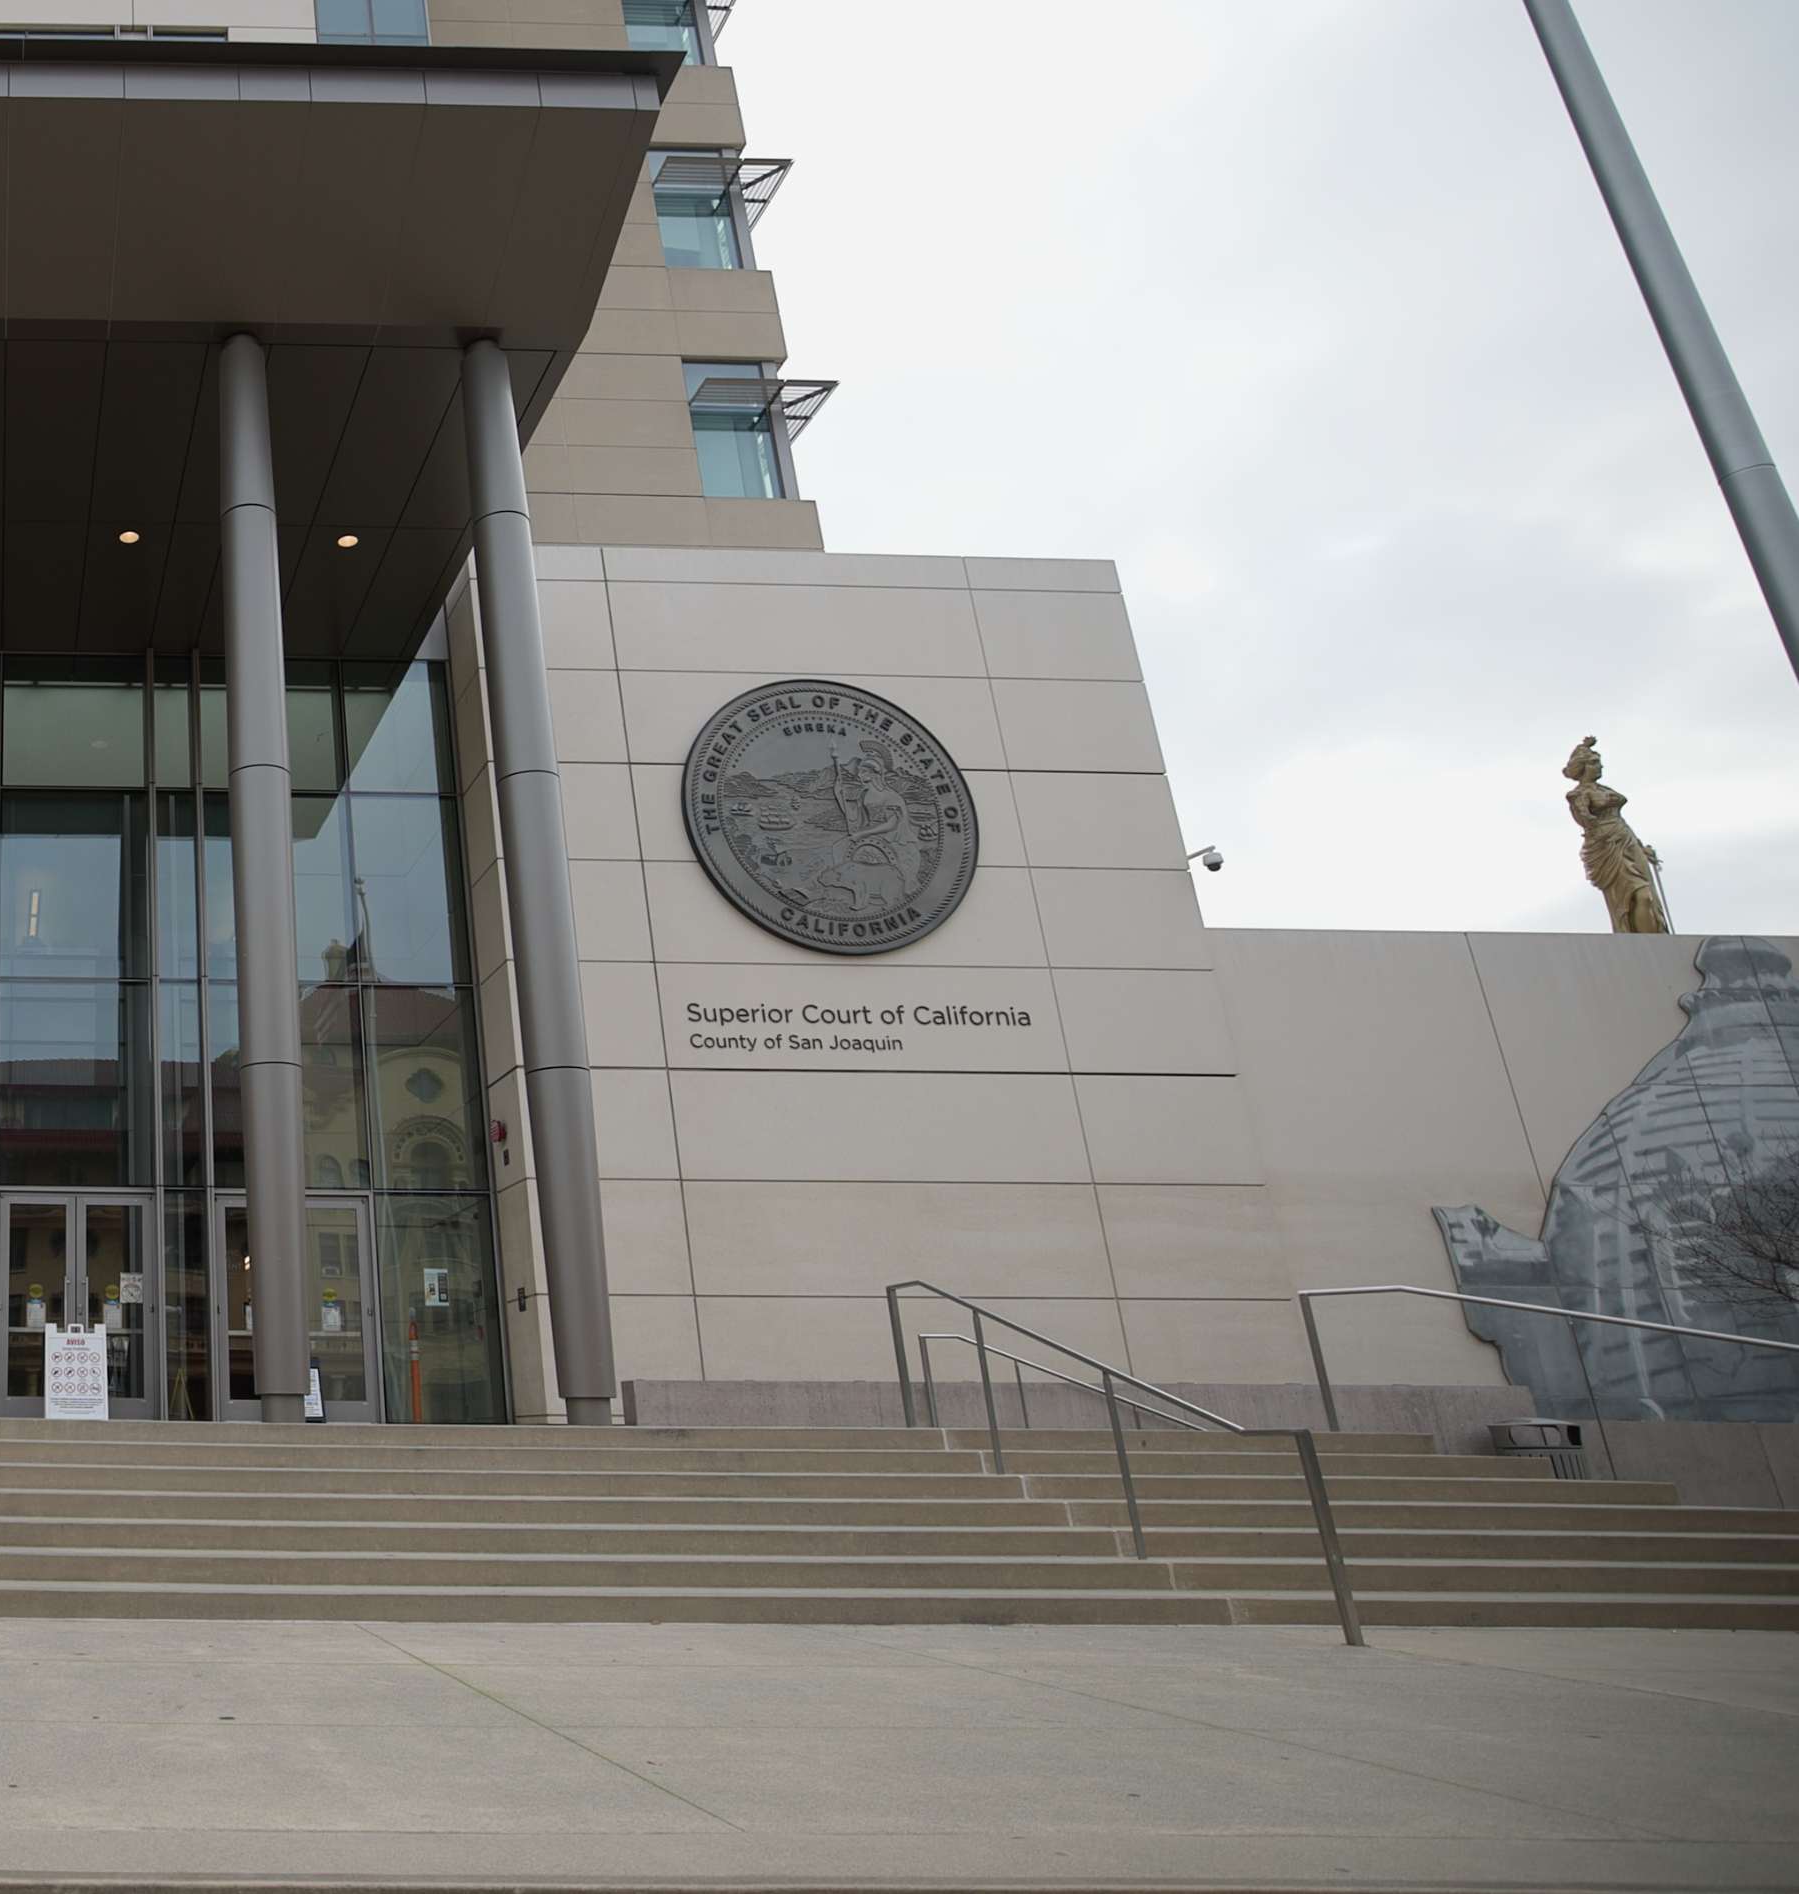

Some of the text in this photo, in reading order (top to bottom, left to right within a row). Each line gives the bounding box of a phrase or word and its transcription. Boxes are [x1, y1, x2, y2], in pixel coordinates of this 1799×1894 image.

[783, 723, 847, 736] EUREKA
[703, 695, 962, 834] THE GREAT SEAL OF THE STATE OF
[780, 907, 921, 937] CALIFORNIA
[687, 1004, 1031, 1027] Superior Court of California
[690, 1034, 903, 1053] County of San Joaquin
